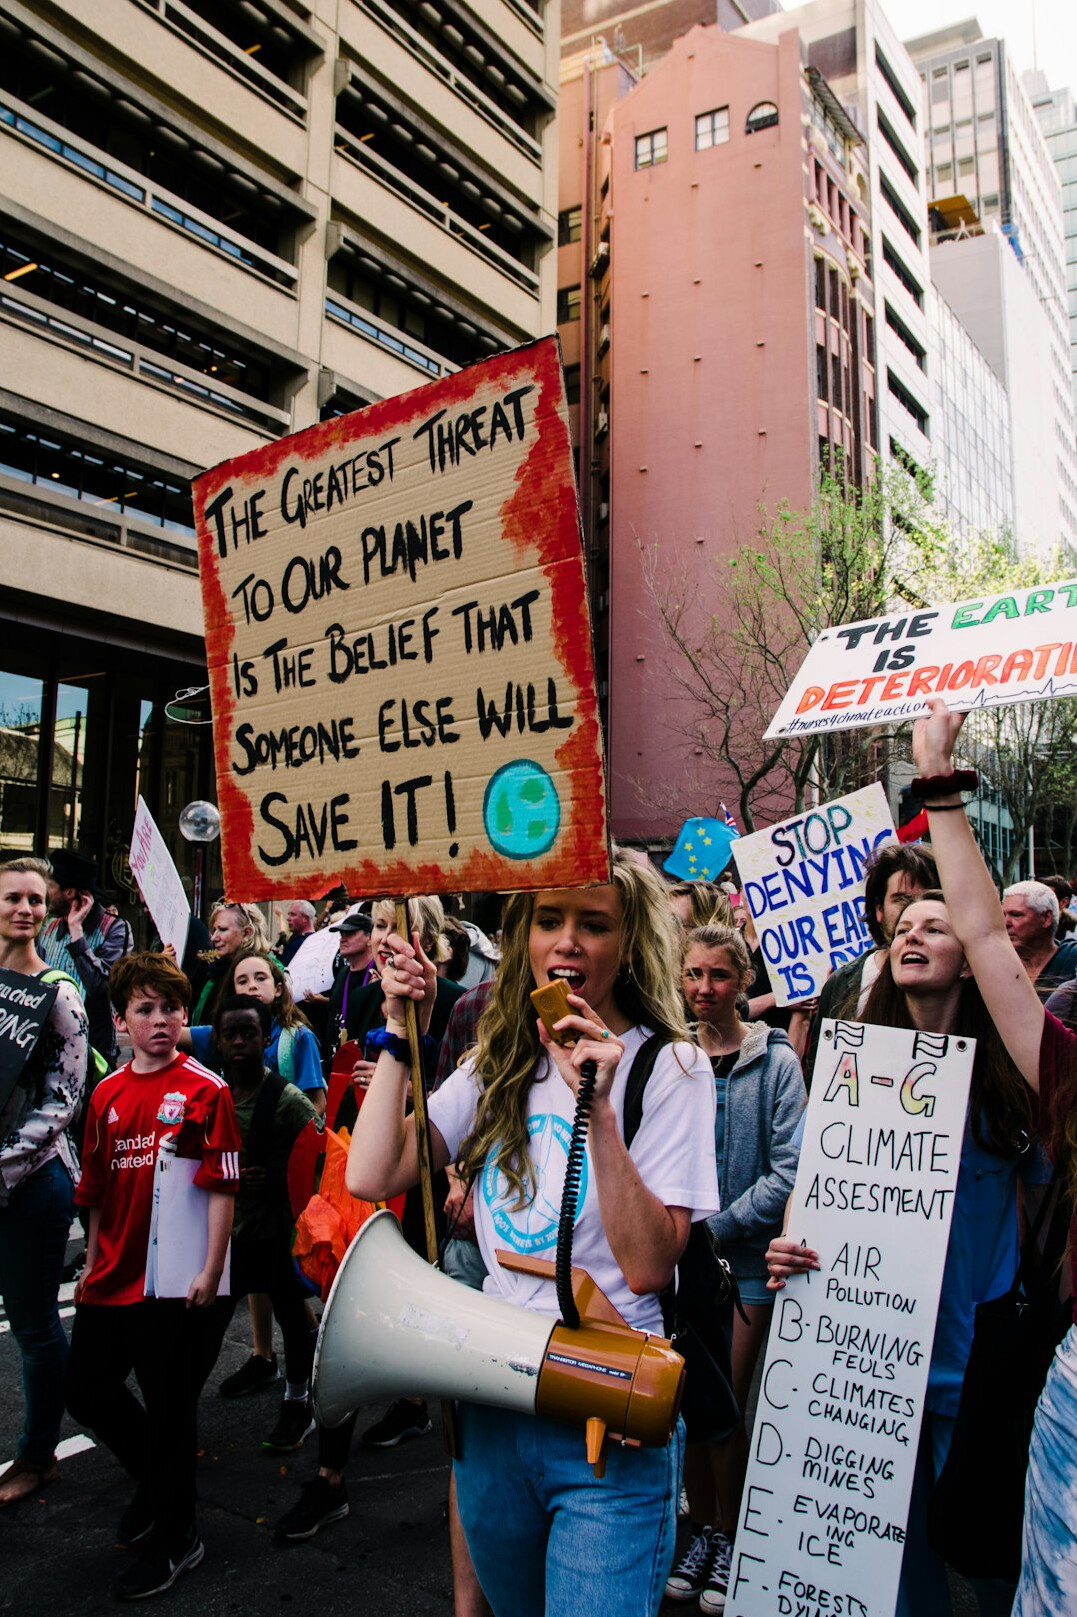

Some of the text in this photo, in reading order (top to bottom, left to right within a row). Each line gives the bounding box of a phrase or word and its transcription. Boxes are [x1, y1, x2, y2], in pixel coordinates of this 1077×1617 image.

[205, 384, 535, 558] THE GREATEST THREAT
[231, 500, 474, 624] TO OUR PLANET
[234, 590, 541, 700] IS THE BELIEF THAT
[837, 611, 939, 651] THE
[872, 645, 917, 673] IS
[232, 677, 575, 776] SOMEONE ELSE WILL
[257, 792, 359, 867] SAVE
[771, 804, 852, 868] STOP
[761, 914, 825, 966] OUR
[778, 961, 815, 1001] IS
[820, 1121, 950, 1174] CLIMATE
[805, 1173, 954, 1220] ASSESMENT
[830, 1242, 882, 1281] AIR
[826, 1278, 917, 1314] POLLUTION
[816, 1315, 924, 1367] BURNING
[832, 1350, 896, 1380] FEULS
[812, 1373, 915, 1418] CLIMATES
[808, 1400, 909, 1447] CHANGING
[802, 1459, 875, 1499] MINES
[804, 1436, 895, 1480] DIGGING
[793, 1494, 907, 1544] EVAPORATE
[826, 1524, 855, 1549] ING
[798, 1531, 843, 1567] ICE
[778, 1570, 868, 1617] FORESTS
